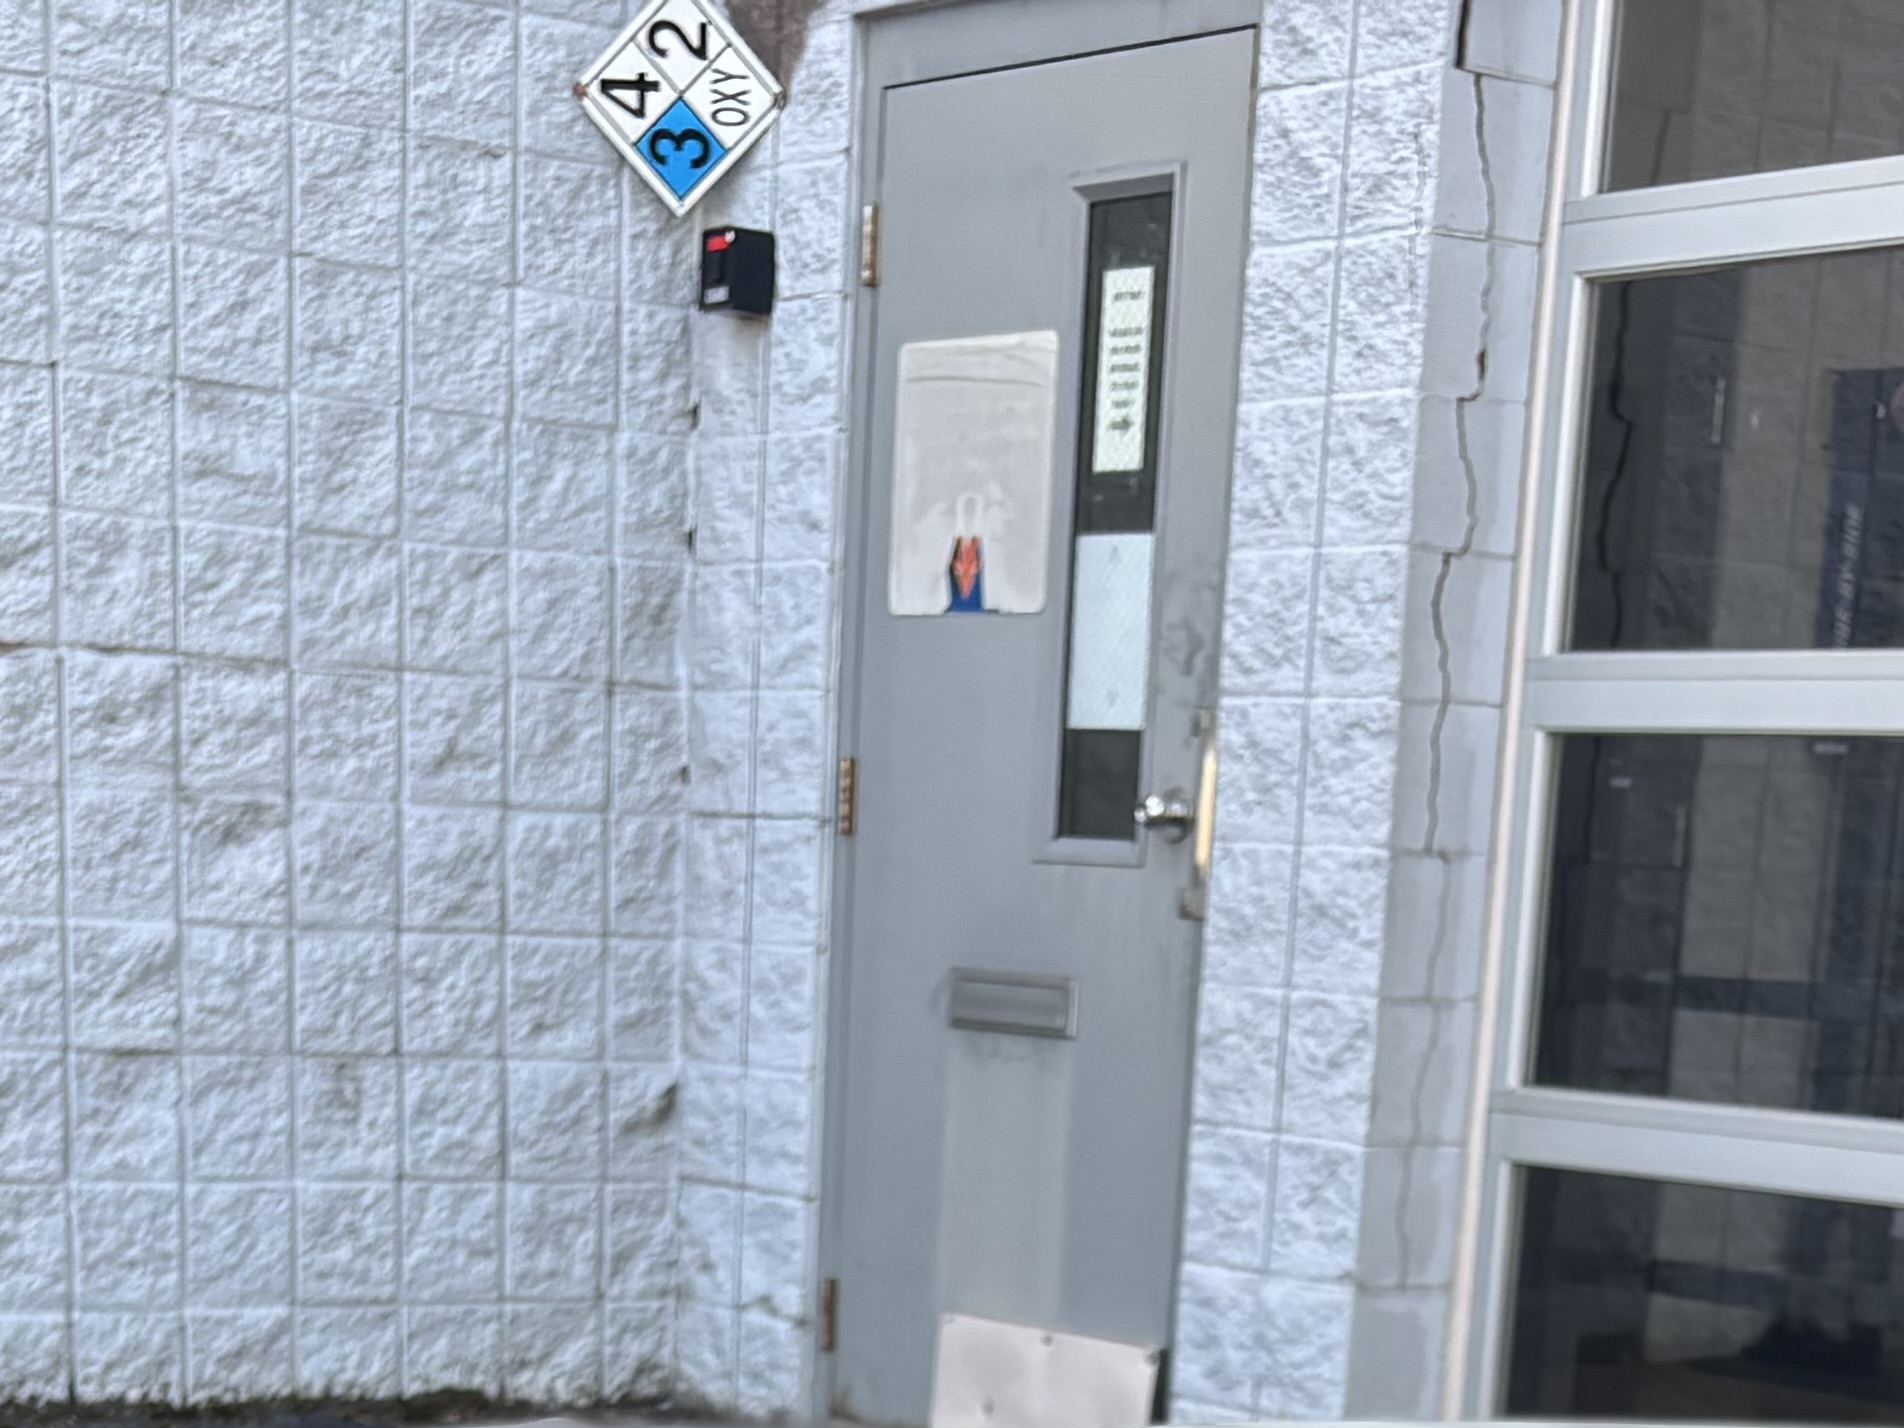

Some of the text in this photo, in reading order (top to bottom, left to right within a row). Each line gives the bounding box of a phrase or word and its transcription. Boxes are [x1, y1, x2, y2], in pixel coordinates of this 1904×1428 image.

[648, 19, 708, 60] 2
[600, 72, 659, 118] 4
[711, 67, 751, 127] OXY
[649, 129, 711, 169] 3
